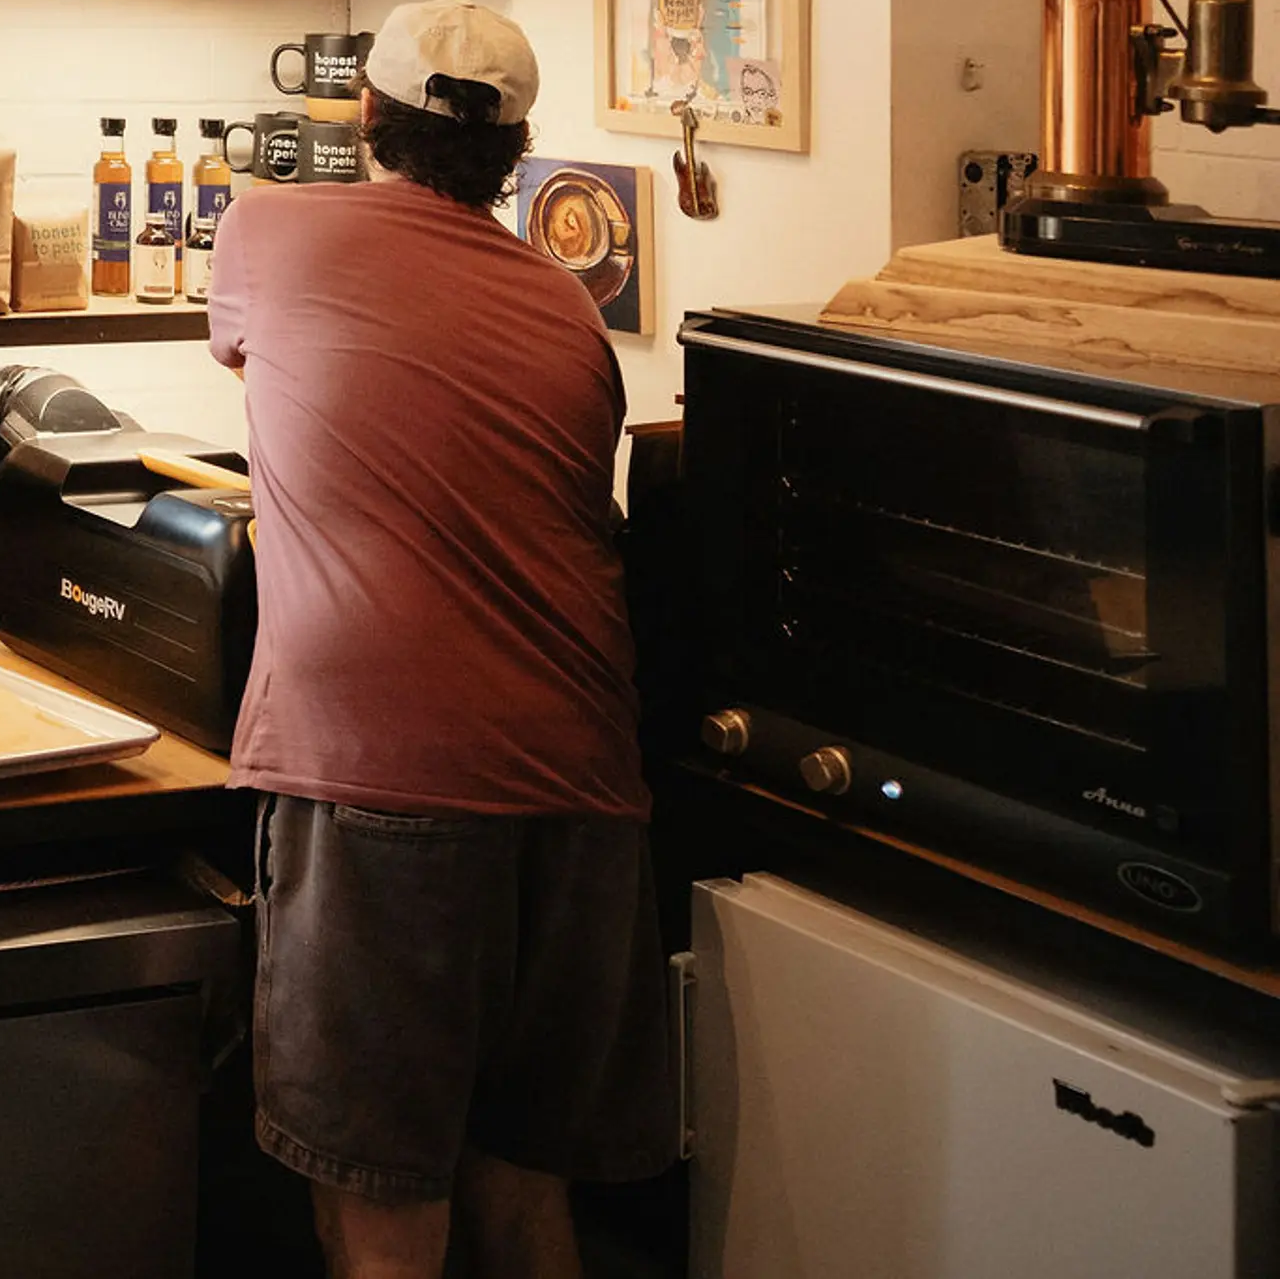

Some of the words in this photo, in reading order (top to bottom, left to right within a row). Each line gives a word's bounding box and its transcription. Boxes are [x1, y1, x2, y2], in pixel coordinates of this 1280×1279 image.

[314, 52, 357, 65] honest
[315, 65, 326, 76] to
[329, 67, 357, 79] pete
[313, 140, 356, 156] honest
[313, 155, 326, 165] to
[329, 156, 357, 168] pete
[31, 223, 81, 240] honest
[33, 242, 48, 256] to
[52, 240, 83, 259] pete
[60, 578, 126, 621] BougeRV
